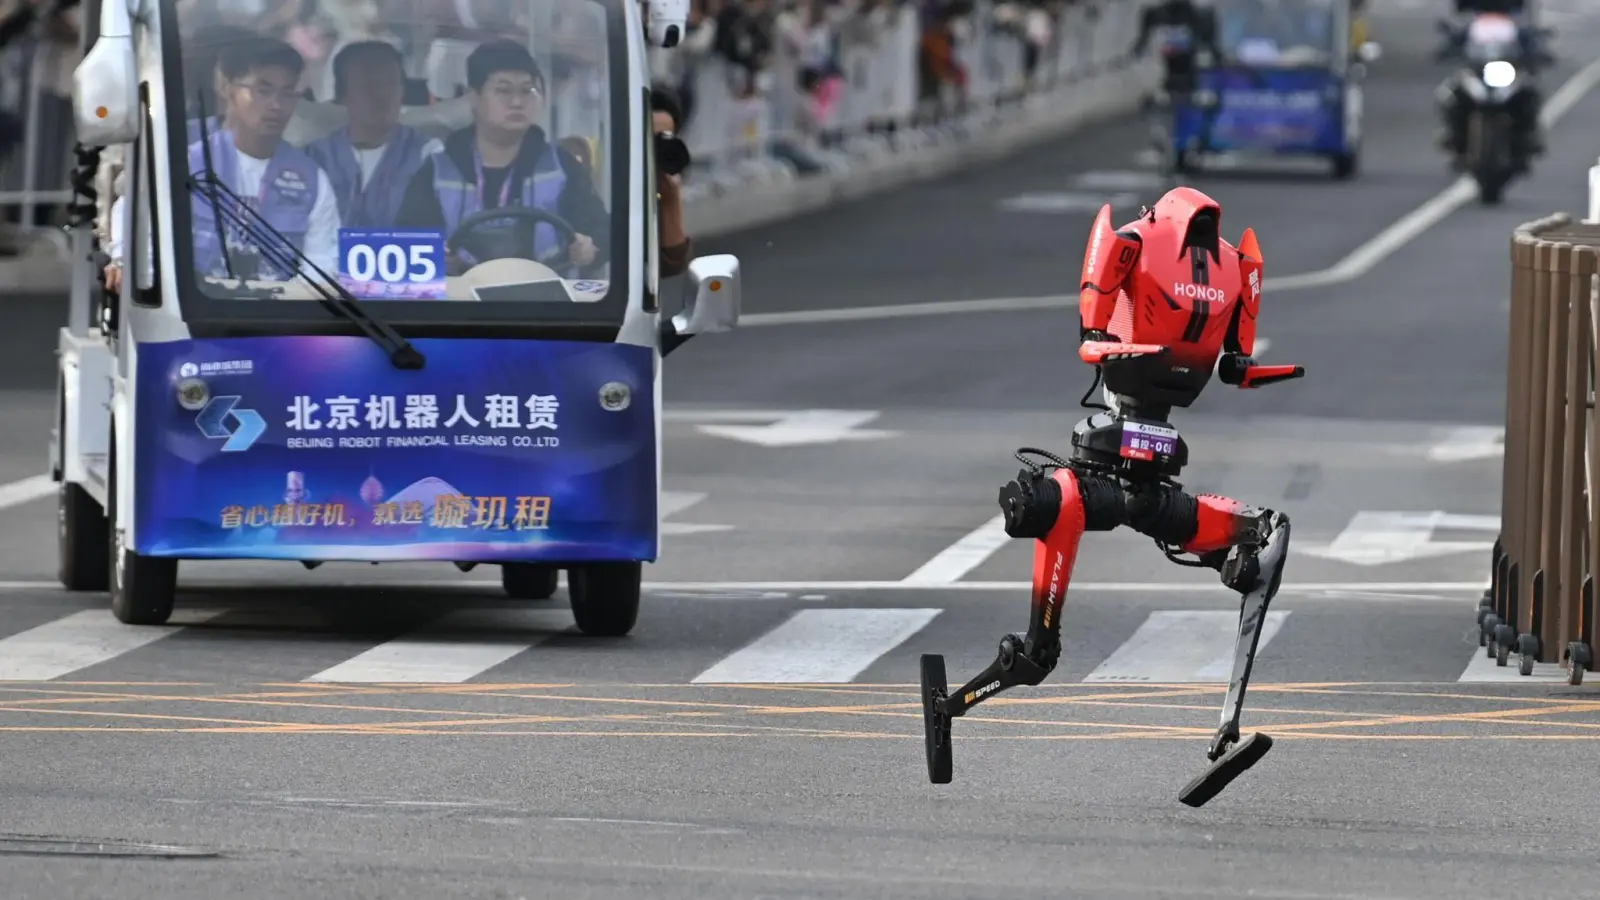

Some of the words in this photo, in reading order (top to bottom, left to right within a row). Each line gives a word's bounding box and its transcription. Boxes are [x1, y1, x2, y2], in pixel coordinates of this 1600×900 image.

[347, 244, 437, 282] 005
[1173, 282, 1225, 304] HONOR
[286, 394, 559, 430] 北京机器人租赁
[287, 437, 333, 448] BEIJING
[339, 437, 381, 448] ROBOT
[387, 436, 449, 447] FINANCIAL
[454, 436, 507, 447] LEASING
[1049, 551, 1063, 604] FLASH
[975, 680, 1001, 698] SPEED
